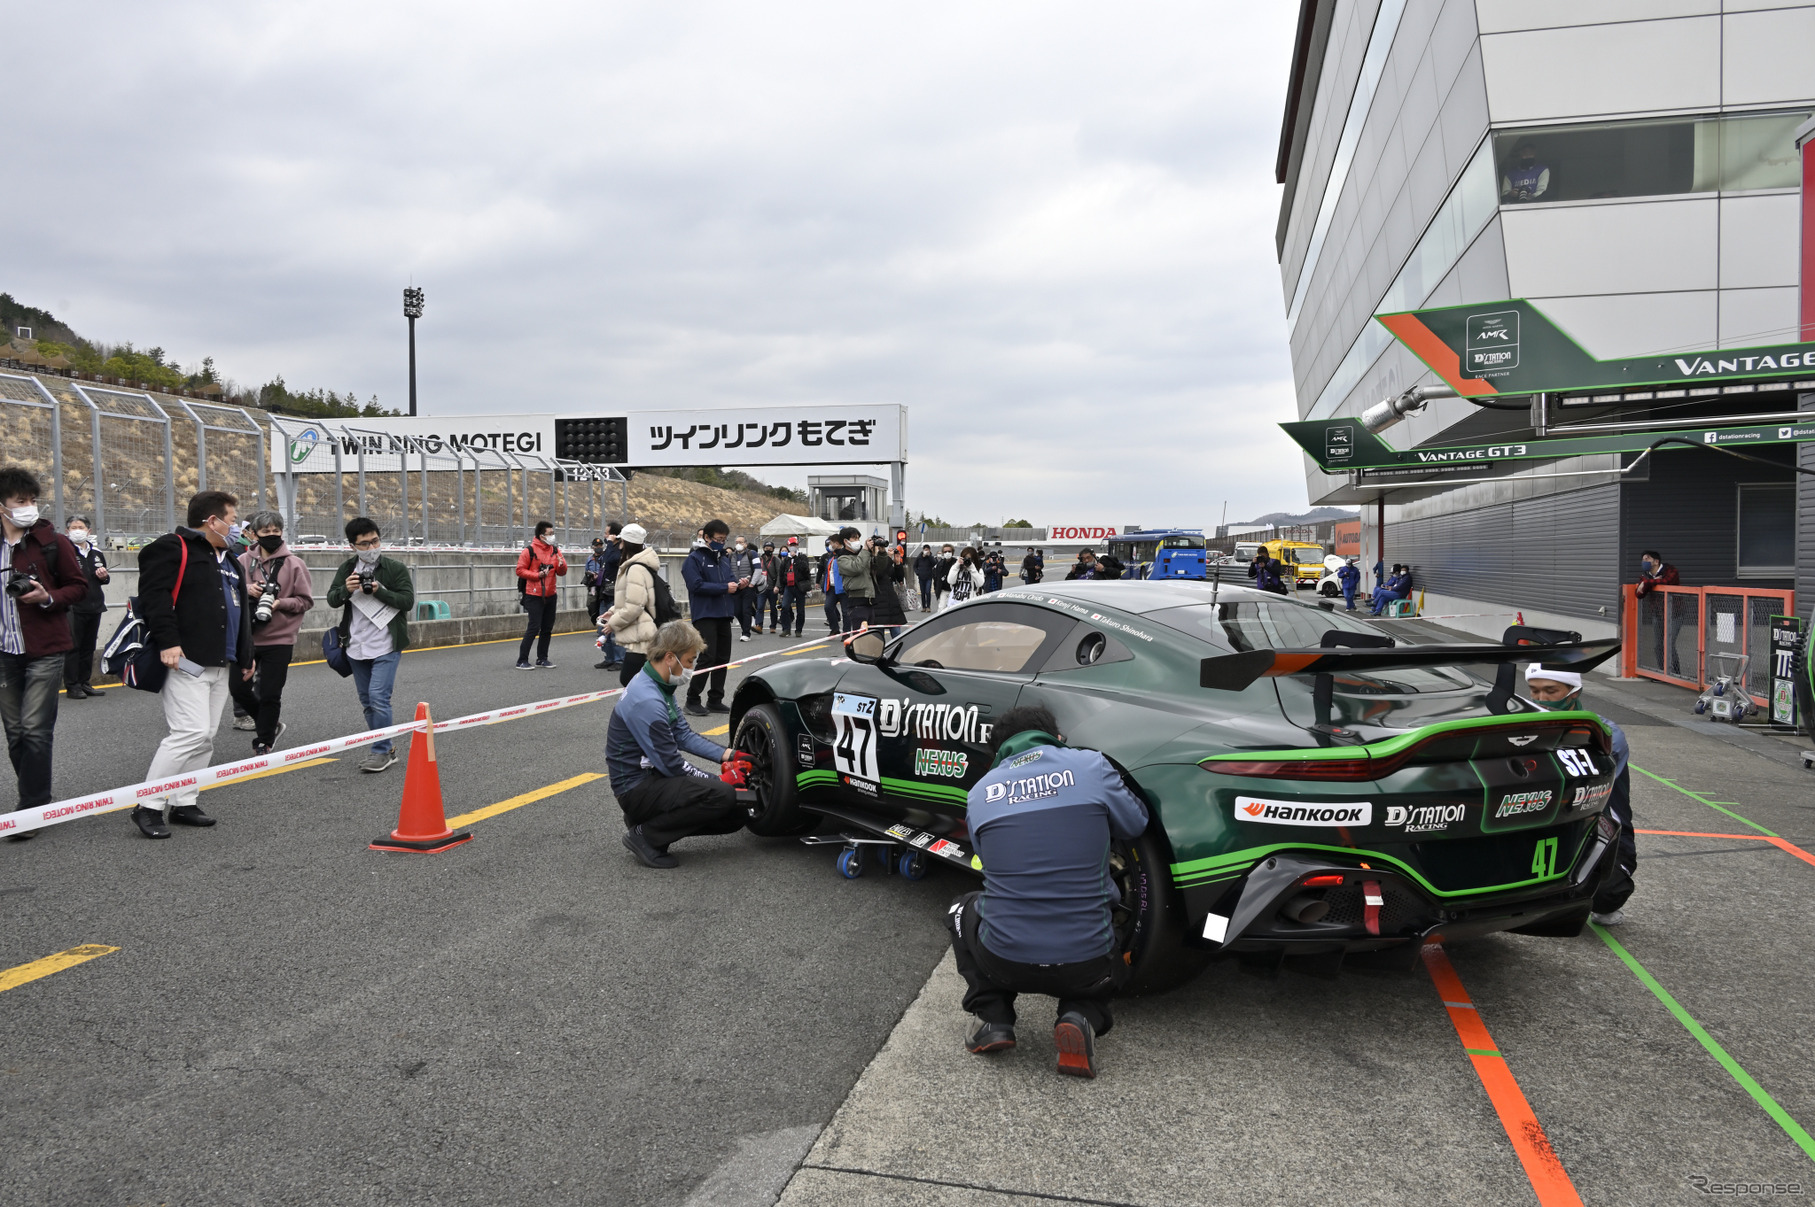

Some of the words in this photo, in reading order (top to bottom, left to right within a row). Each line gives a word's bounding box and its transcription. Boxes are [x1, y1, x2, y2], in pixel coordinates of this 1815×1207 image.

[1674, 352, 1815, 376] VANTAGE
[450, 432, 541, 453] MOTEGI
[650, 419, 876, 450] ツインリンクもてぎ
[1718, 432, 1760, 440] dstationracing
[1418, 450, 1485, 462] VANTAGE
[1487, 445, 1526, 457] GT3
[1051, 527, 1117, 539] HONDA
[1056, 601, 1071, 610] Kenji
[1071, 604, 1089, 615] Hama
[1100, 616, 1120, 628] Takuro
[1120, 624, 1154, 642] Shinohara
[880, 698, 979, 743] D'STATION
[837, 716, 871, 776] 47
[254, 760, 268, 769] TWIN
[915, 748, 969, 778] NEXUS
[1009, 750, 1043, 769] NEXUS
[1556, 749, 1599, 777] ST-Z
[216, 767, 239, 779] MOTEGI
[240, 765, 254, 773] RING
[164, 782, 180, 792] RING
[180, 777, 197, 788] TWIN
[985, 769, 1075, 803] D'STATION
[137, 787, 163, 798] MOTEGI
[1008, 789, 1058, 804] RACING
[75, 803, 94, 813] RING
[94, 797, 114, 808] TWIN
[1495, 790, 1552, 818] NEXUS
[43, 807, 74, 820] MOTEGI
[1384, 804, 1466, 826] D'STATION
[1404, 822, 1448, 833] RACING
[1531, 837, 1558, 880] 47
